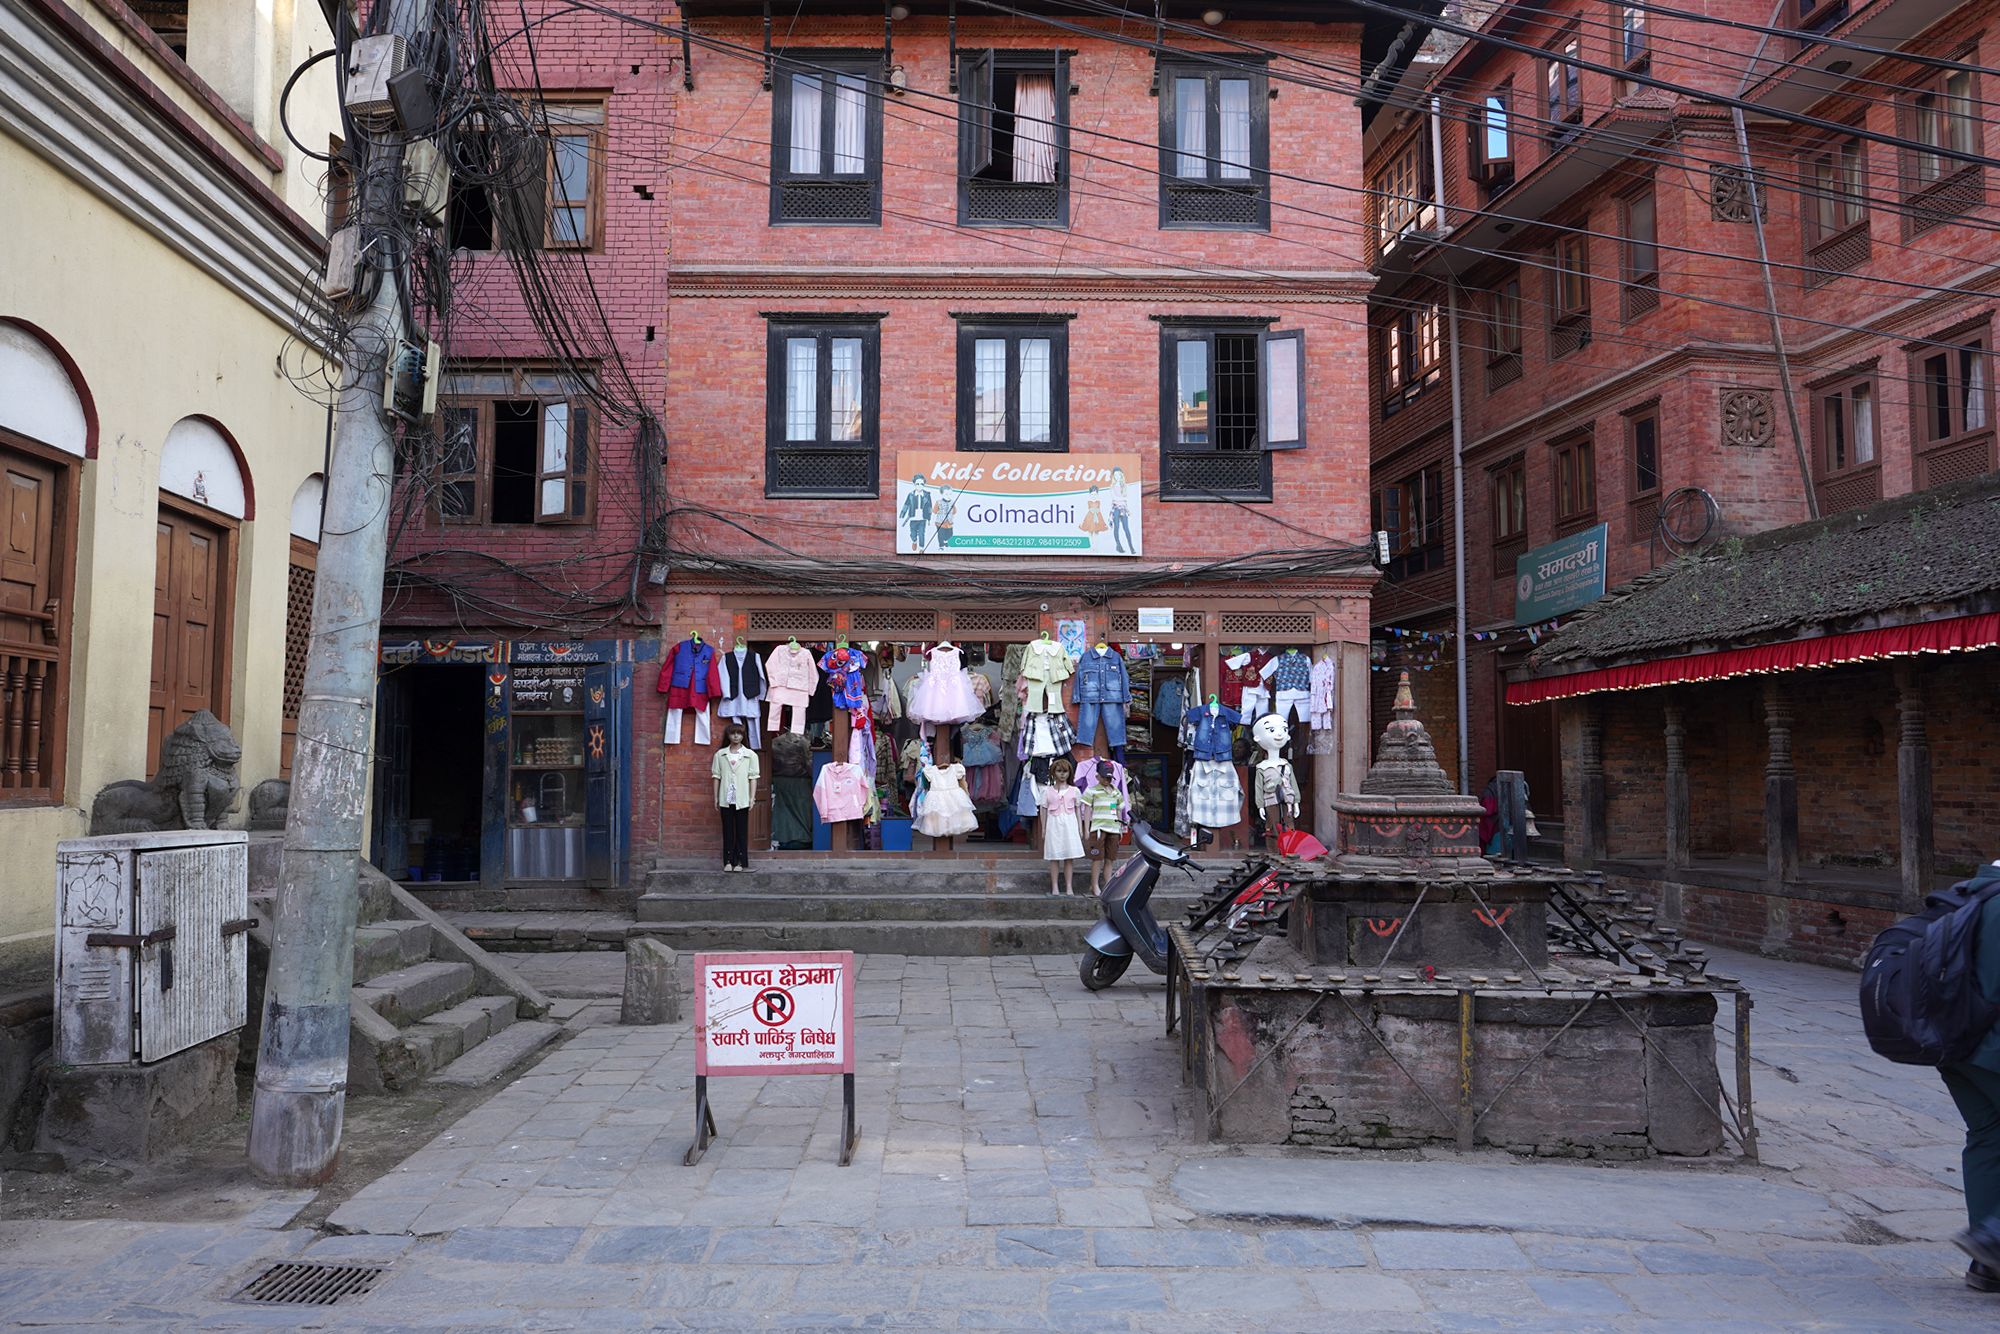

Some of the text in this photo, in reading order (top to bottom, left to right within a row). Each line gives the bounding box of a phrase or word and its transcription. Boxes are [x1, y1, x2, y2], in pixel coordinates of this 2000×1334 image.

[930, 461, 1111, 483] Kids Collection
[967, 504, 1075, 524] Golmadhi
[711, 965, 835, 988] सम्पदा क्षेत्रमा
[711, 1028, 750, 1047] सवारी
[800, 1028, 836, 1046] निषेध
